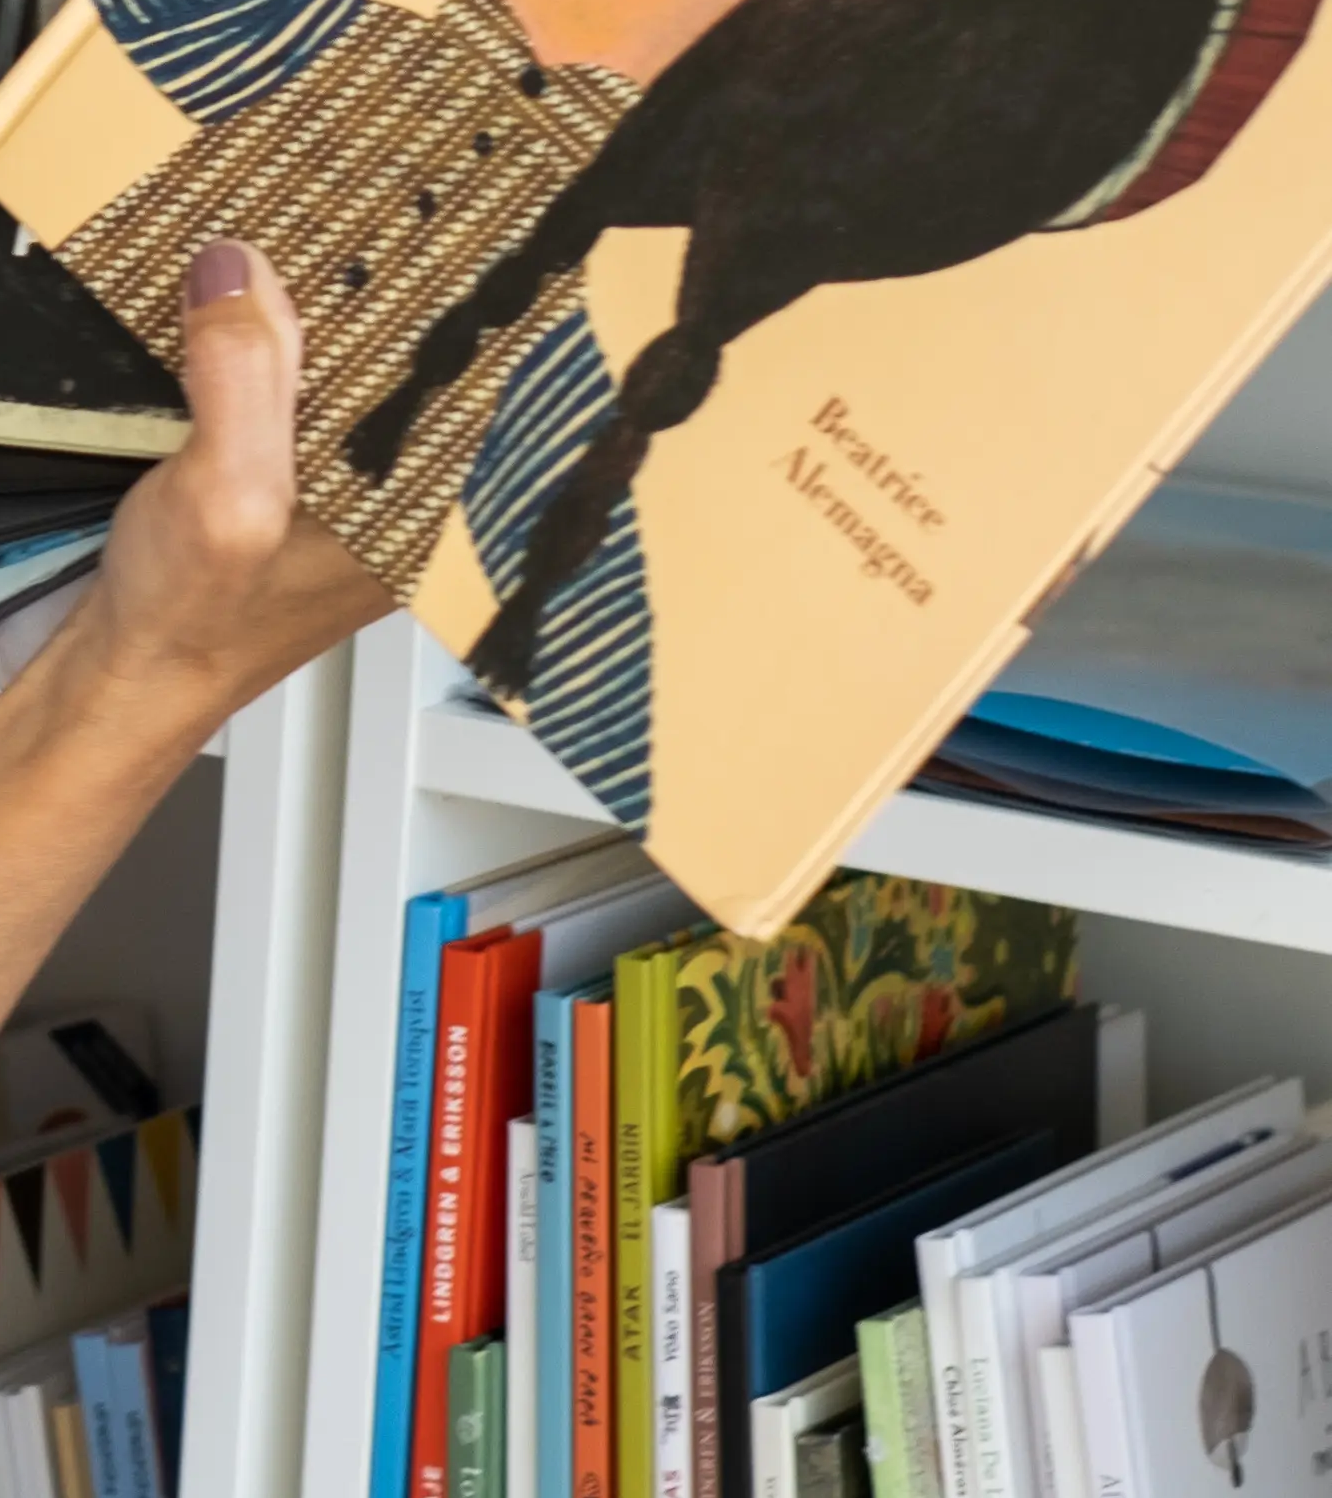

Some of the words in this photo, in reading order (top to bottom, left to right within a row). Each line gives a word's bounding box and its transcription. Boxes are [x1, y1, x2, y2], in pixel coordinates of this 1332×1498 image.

[770, 442, 939, 609] Alemagna
[807, 393, 950, 537] Beatrice
[439, 1025, 470, 1160] ERIKSSON
[438, 1165, 462, 1186] &
[429, 1192, 463, 1325] LINDGREN
[623, 1284, 642, 1363] ATAK
